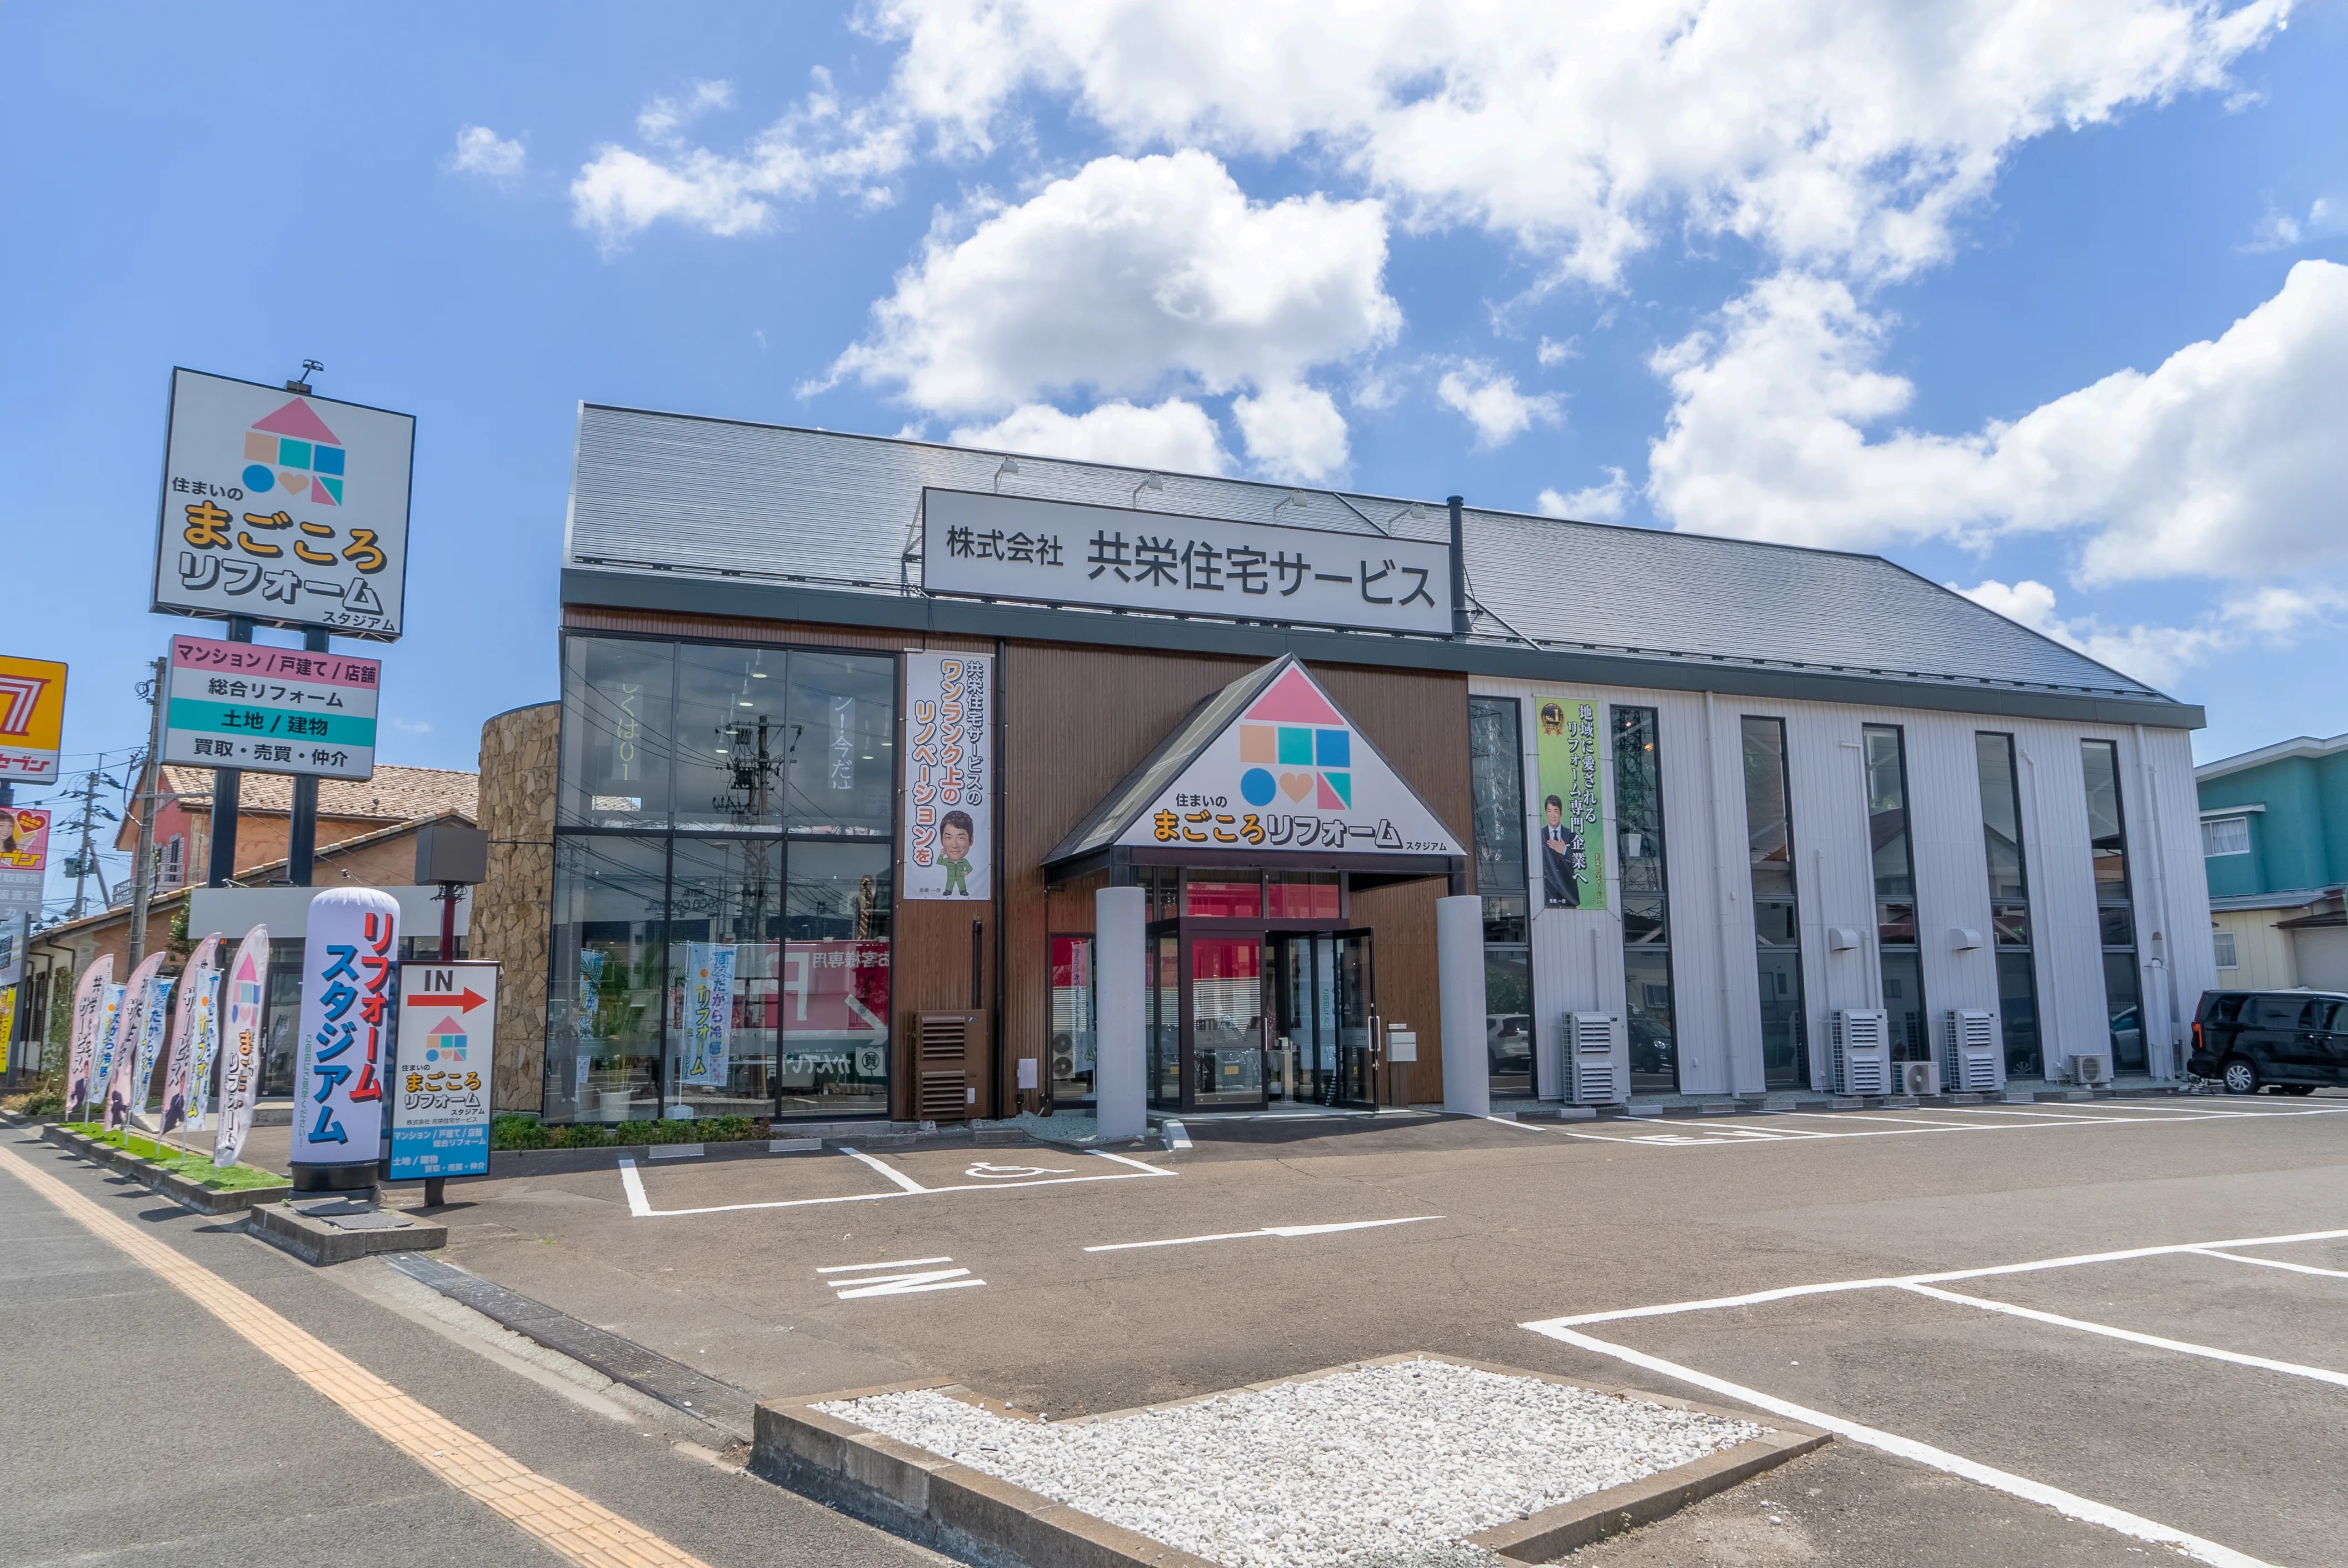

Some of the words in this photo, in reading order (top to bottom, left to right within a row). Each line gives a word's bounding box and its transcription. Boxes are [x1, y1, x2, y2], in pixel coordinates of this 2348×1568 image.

[172, 477, 243, 502] 住まいの
[183, 500, 387, 574] まごころ
[946, 524, 1063, 567] 株式会社
[1087, 529, 1435, 609] 共栄住宅サービス
[179, 552, 383, 615] リフォーム
[322, 611, 396, 632] スタジアム
[208, 678, 343, 708] 総合リフォーム
[940, 659, 964, 806] ワンランク上の
[966, 660, 983, 806] 共栄住宅サービスの
[1578, 704, 1597, 823] 地域に愛される
[912, 699, 938, 868] リノベーションを
[1176, 792, 1227, 808] 住まいの
[1567, 721, 1588, 884] リフォーム専門企業へ
[1406, 841, 1447, 851] スタジアム
[349, 913, 393, 1104] リフォーム
[424, 970, 453, 991] IN
[168, 986, 196, 1087] サービス
[188, 1020, 207, 1118] リフォーム
[308, 944, 360, 1145] スタジアム
[690, 989, 711, 1076] リフォーム
[404, 1093, 481, 1109] リフォーム
[405, 1071, 482, 1093] まごころ
[433, 1138, 486, 1148] 総合リフォーム
